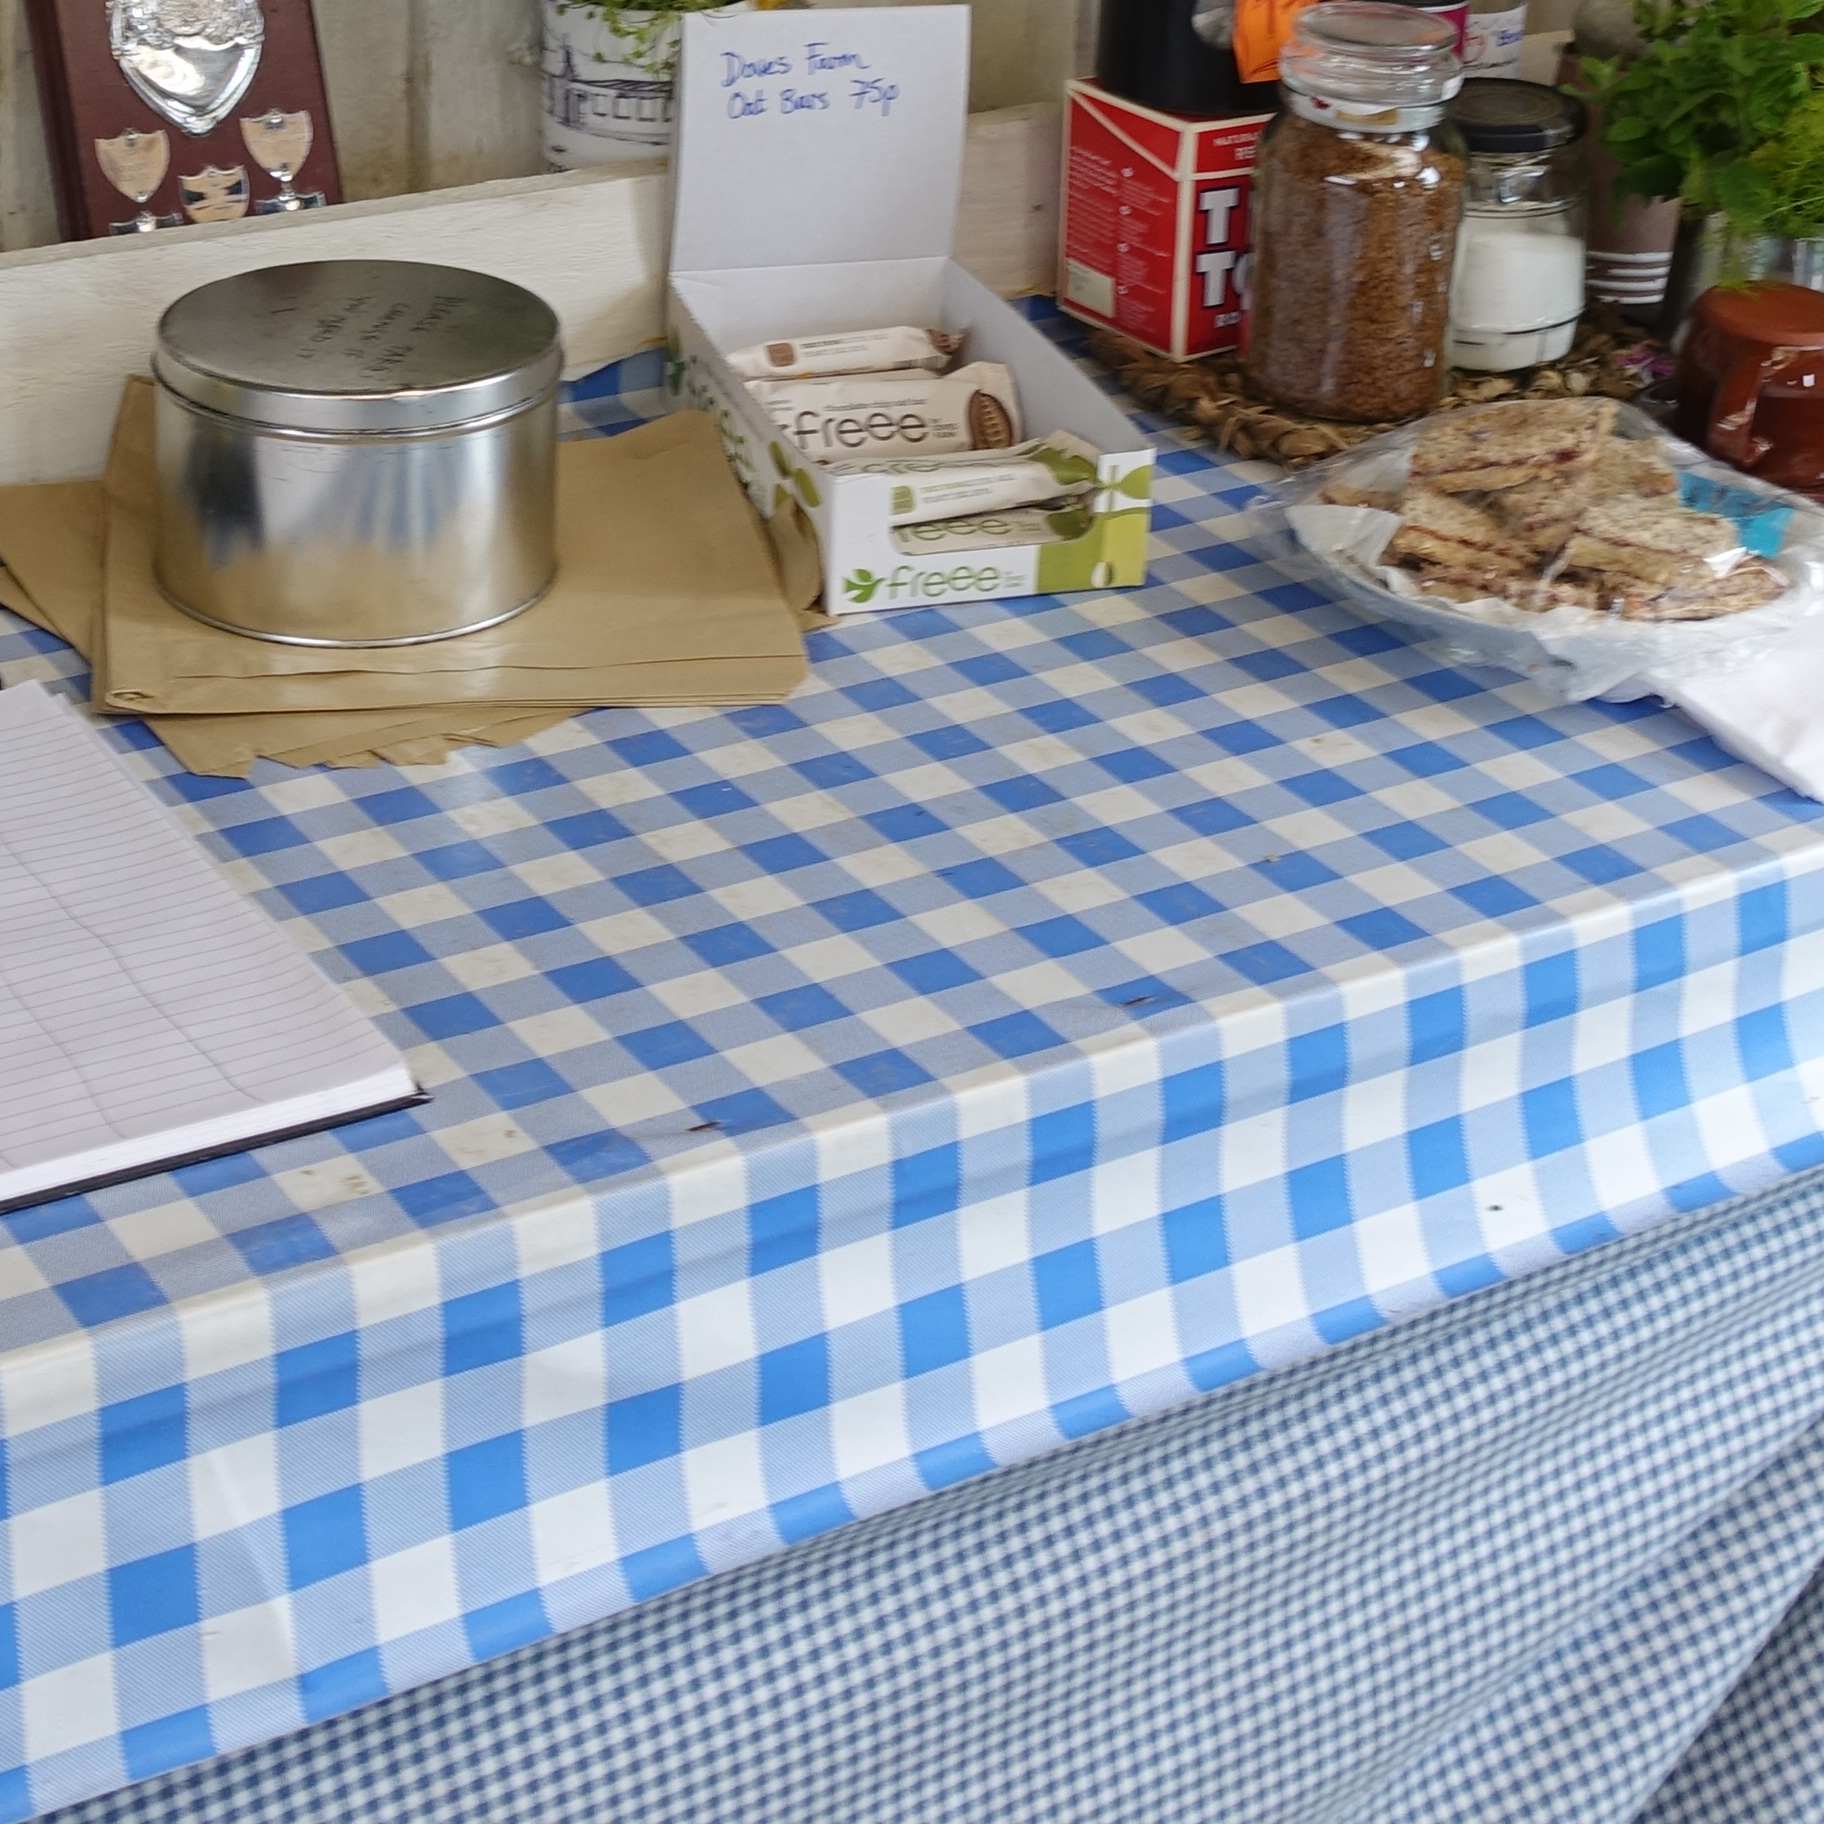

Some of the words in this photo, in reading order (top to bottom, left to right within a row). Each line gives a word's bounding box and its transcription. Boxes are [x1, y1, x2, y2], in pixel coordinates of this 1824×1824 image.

[721, 51, 793, 88] Doves
[803, 42, 872, 76] Farm
[727, 89, 769, 120] Oat
[779, 88, 831, 115] Bars
[793, 410, 930, 450] freee
[887, 564, 1000, 600] freee
